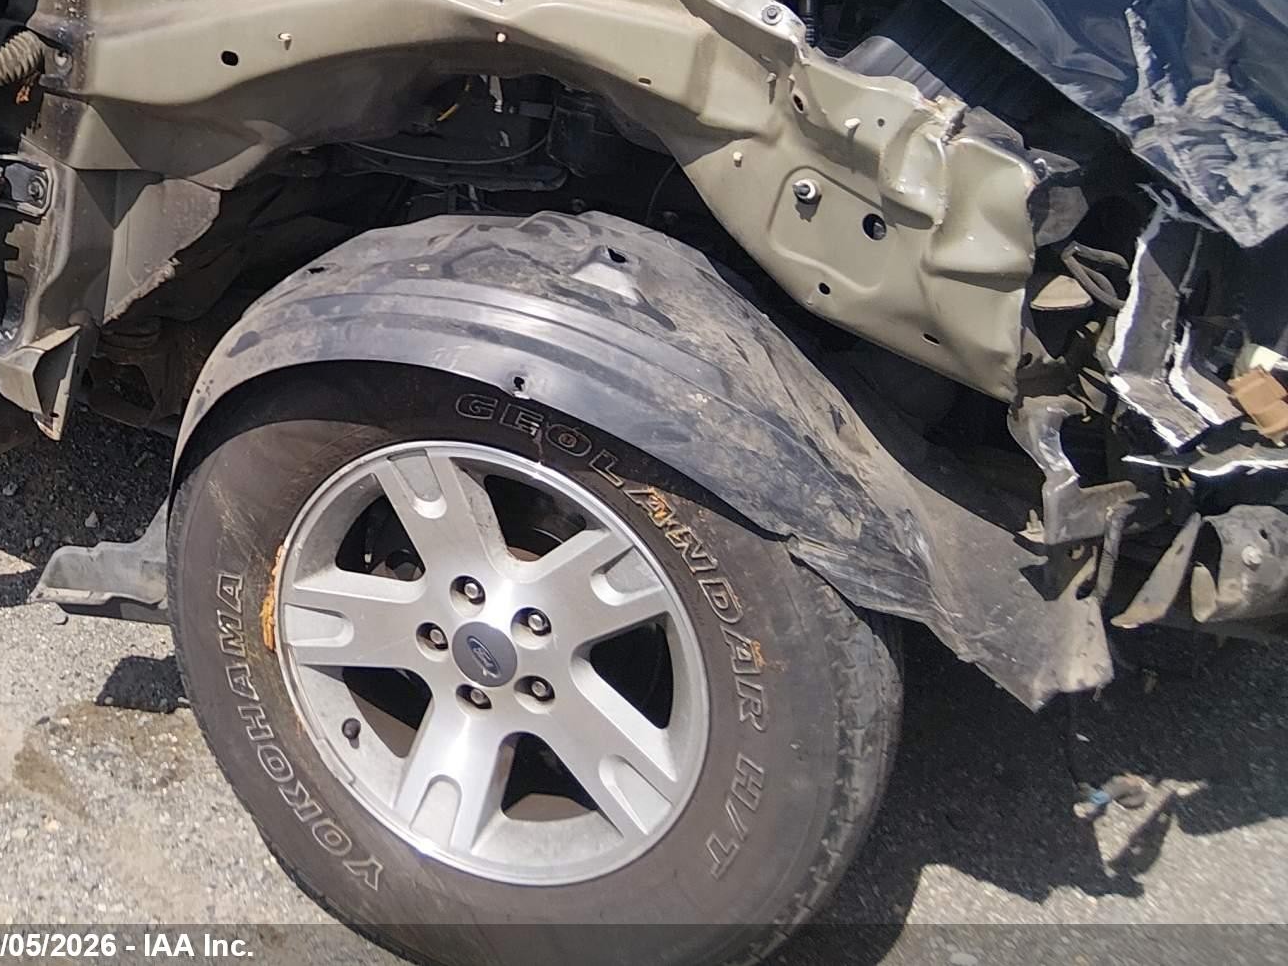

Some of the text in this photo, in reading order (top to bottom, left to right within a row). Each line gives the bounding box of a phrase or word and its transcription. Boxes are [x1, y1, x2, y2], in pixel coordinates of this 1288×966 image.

[216, 573, 383, 891] YOKOHAMA
[455, 393, 770, 880] GEOLANDAR H/T
